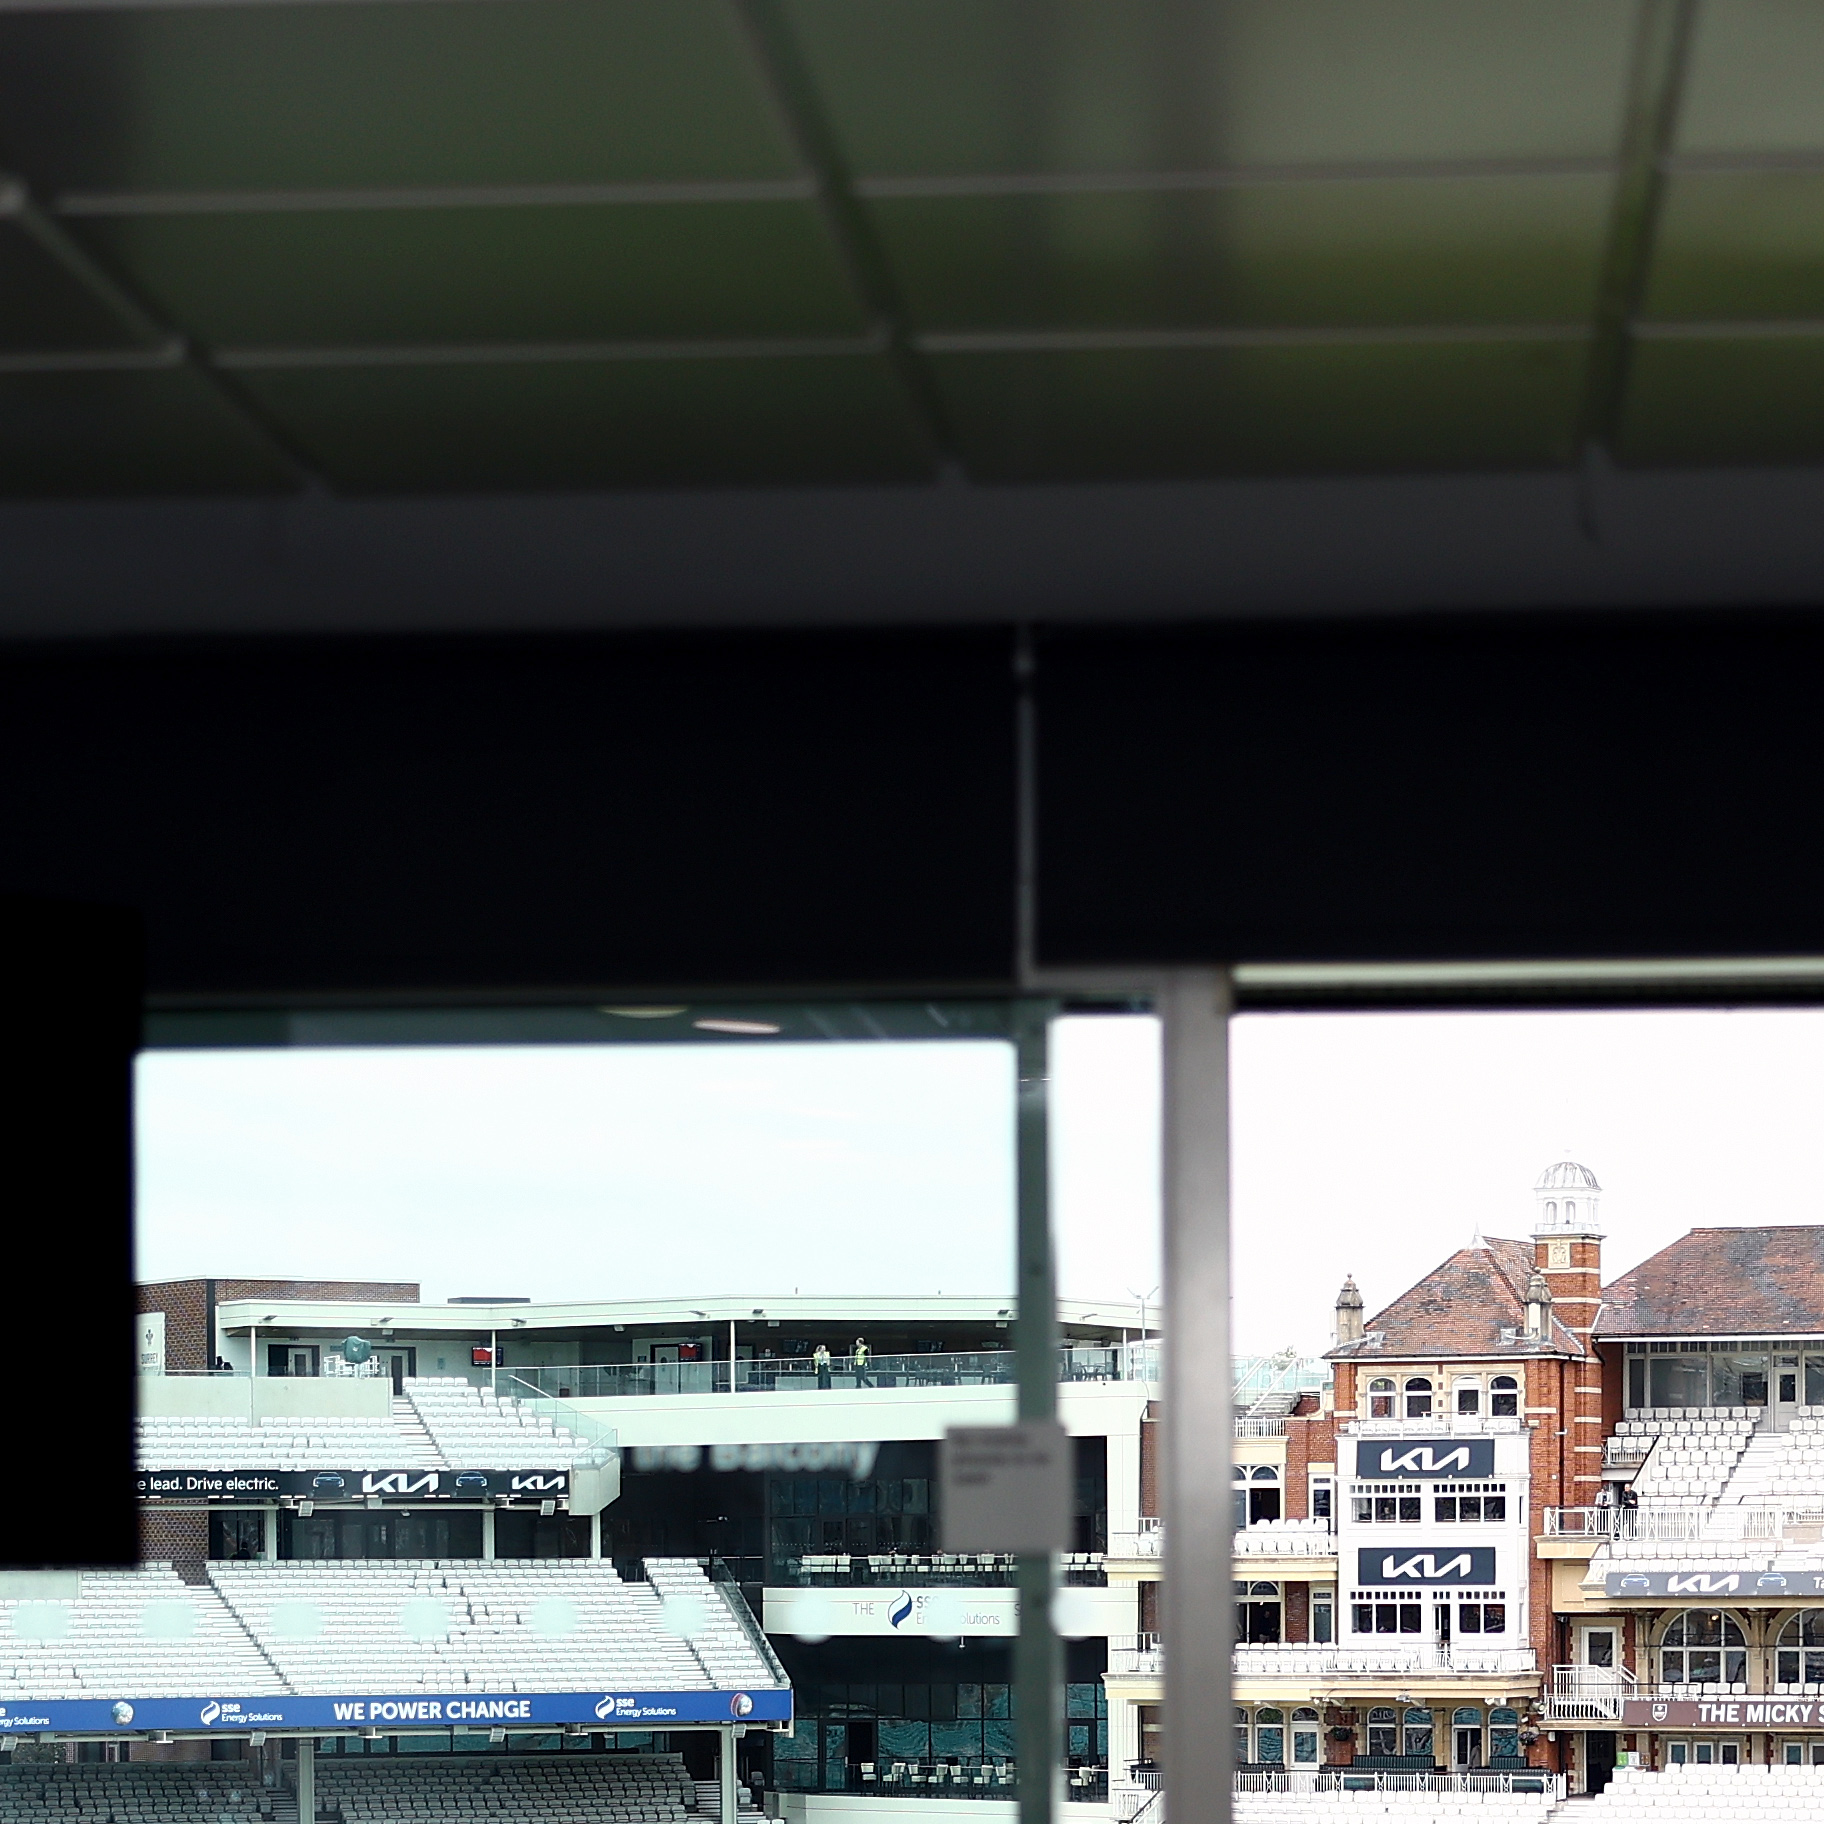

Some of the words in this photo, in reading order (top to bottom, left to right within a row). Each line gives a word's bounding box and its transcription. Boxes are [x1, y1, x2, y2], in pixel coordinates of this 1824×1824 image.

[150, 1476, 183, 1490] lead.
[187, 1476, 223, 1490] Drive
[226, 1476, 279, 1490] electric.
[853, 1603, 875, 1616] THE
[221, 1704, 241, 1713] sse
[616, 1698, 635, 1707] sse
[334, 1703, 365, 1720] WE
[370, 1702, 442, 1720] POWER
[446, 1700, 531, 1719] CHANGE
[616, 1707, 642, 1718] Energy
[642, 1706, 677, 1716] Solutions
[1698, 1704, 1739, 1723] THE
[1746, 1704, 1814, 1723] MICKY
[14, 1716, 50, 1726] Solutions
[221, 1713, 248, 1723] Energy
[248, 1712, 283, 1722] Solutions
